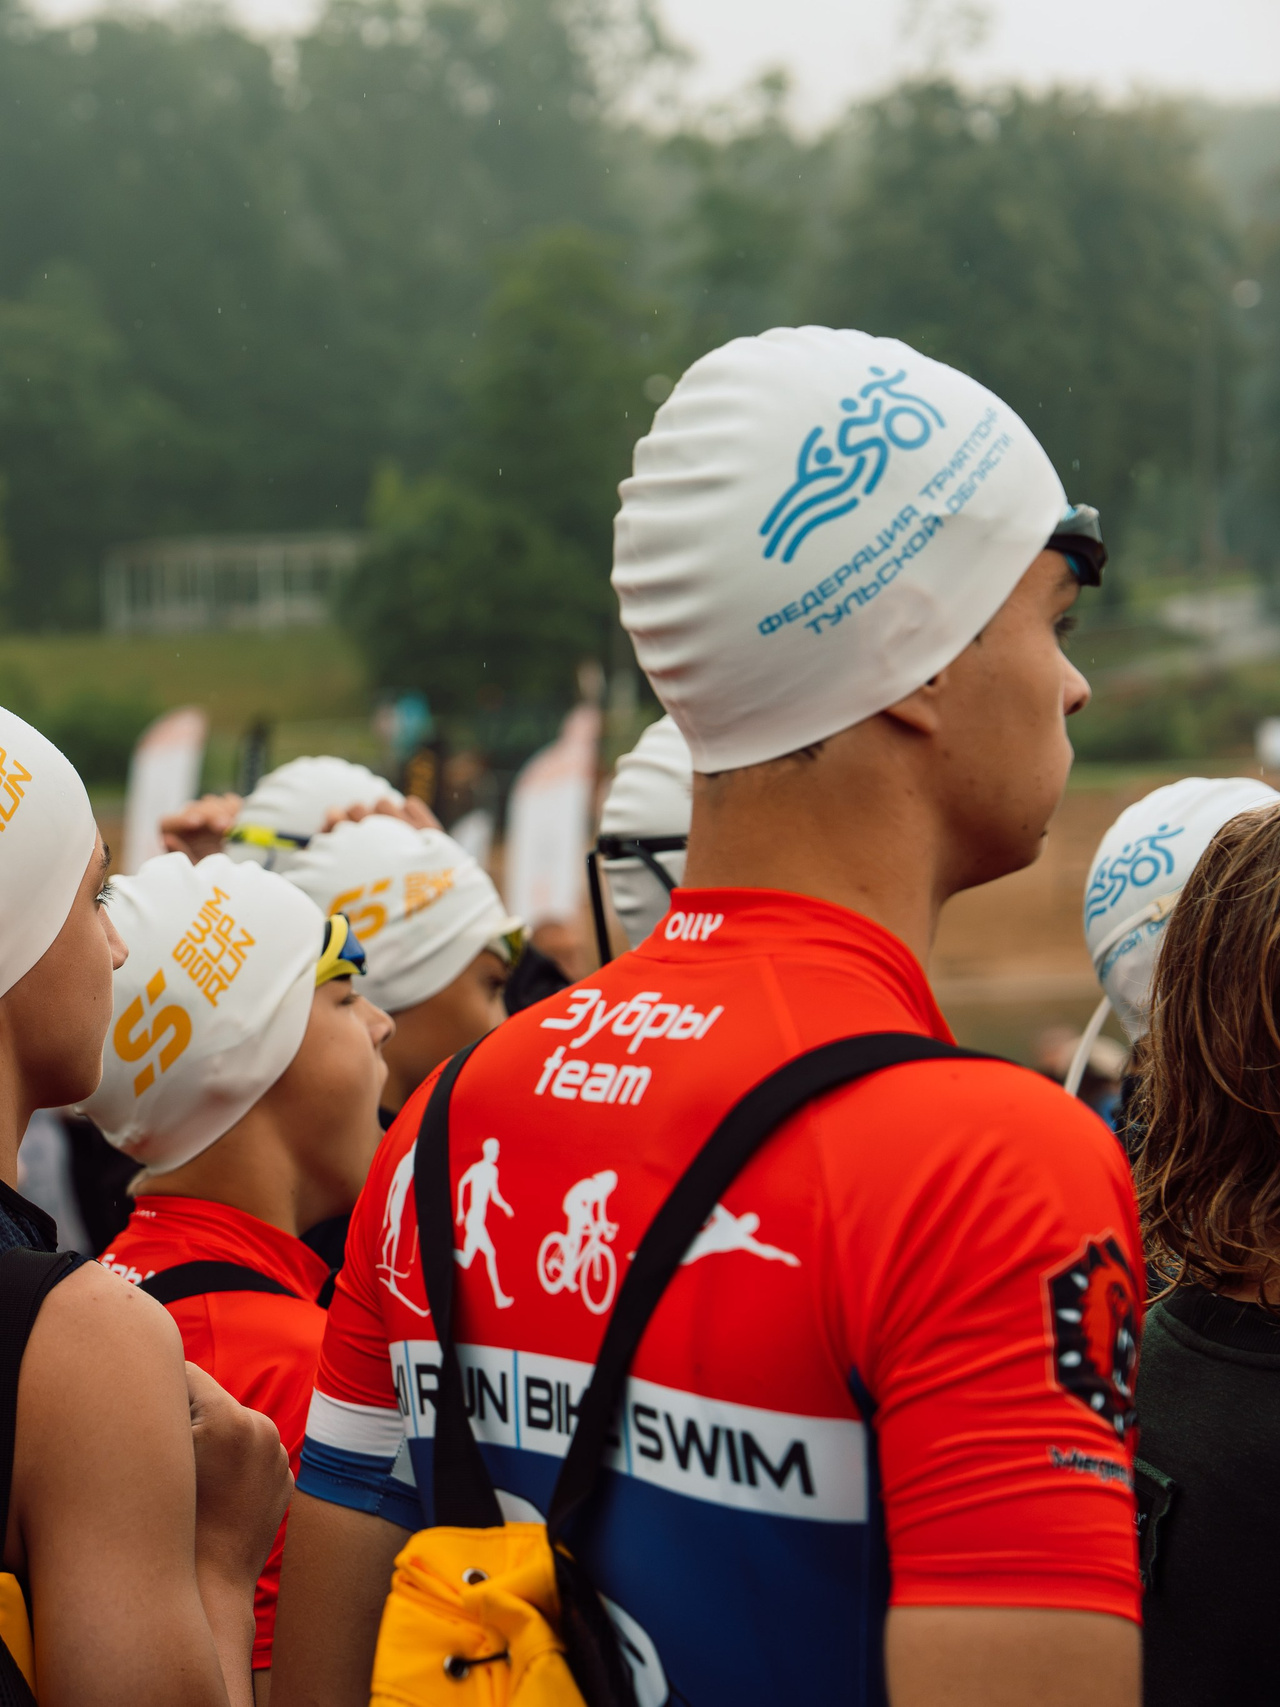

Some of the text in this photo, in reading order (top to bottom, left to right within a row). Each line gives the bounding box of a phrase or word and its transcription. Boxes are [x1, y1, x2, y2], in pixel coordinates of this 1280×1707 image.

[757, 504, 921, 636] ФЕДЕРАЦИЯ
[803, 511, 945, 635] ТУЛЬСКОЙ
[172, 885, 231, 969] SWIM
[187, 913, 236, 988] SUP
[201, 926, 257, 1009] RUN
[540, 988, 725, 1054] Зубры
[534, 1045, 652, 1105] team
[633, 1403, 815, 1497] SWIM
